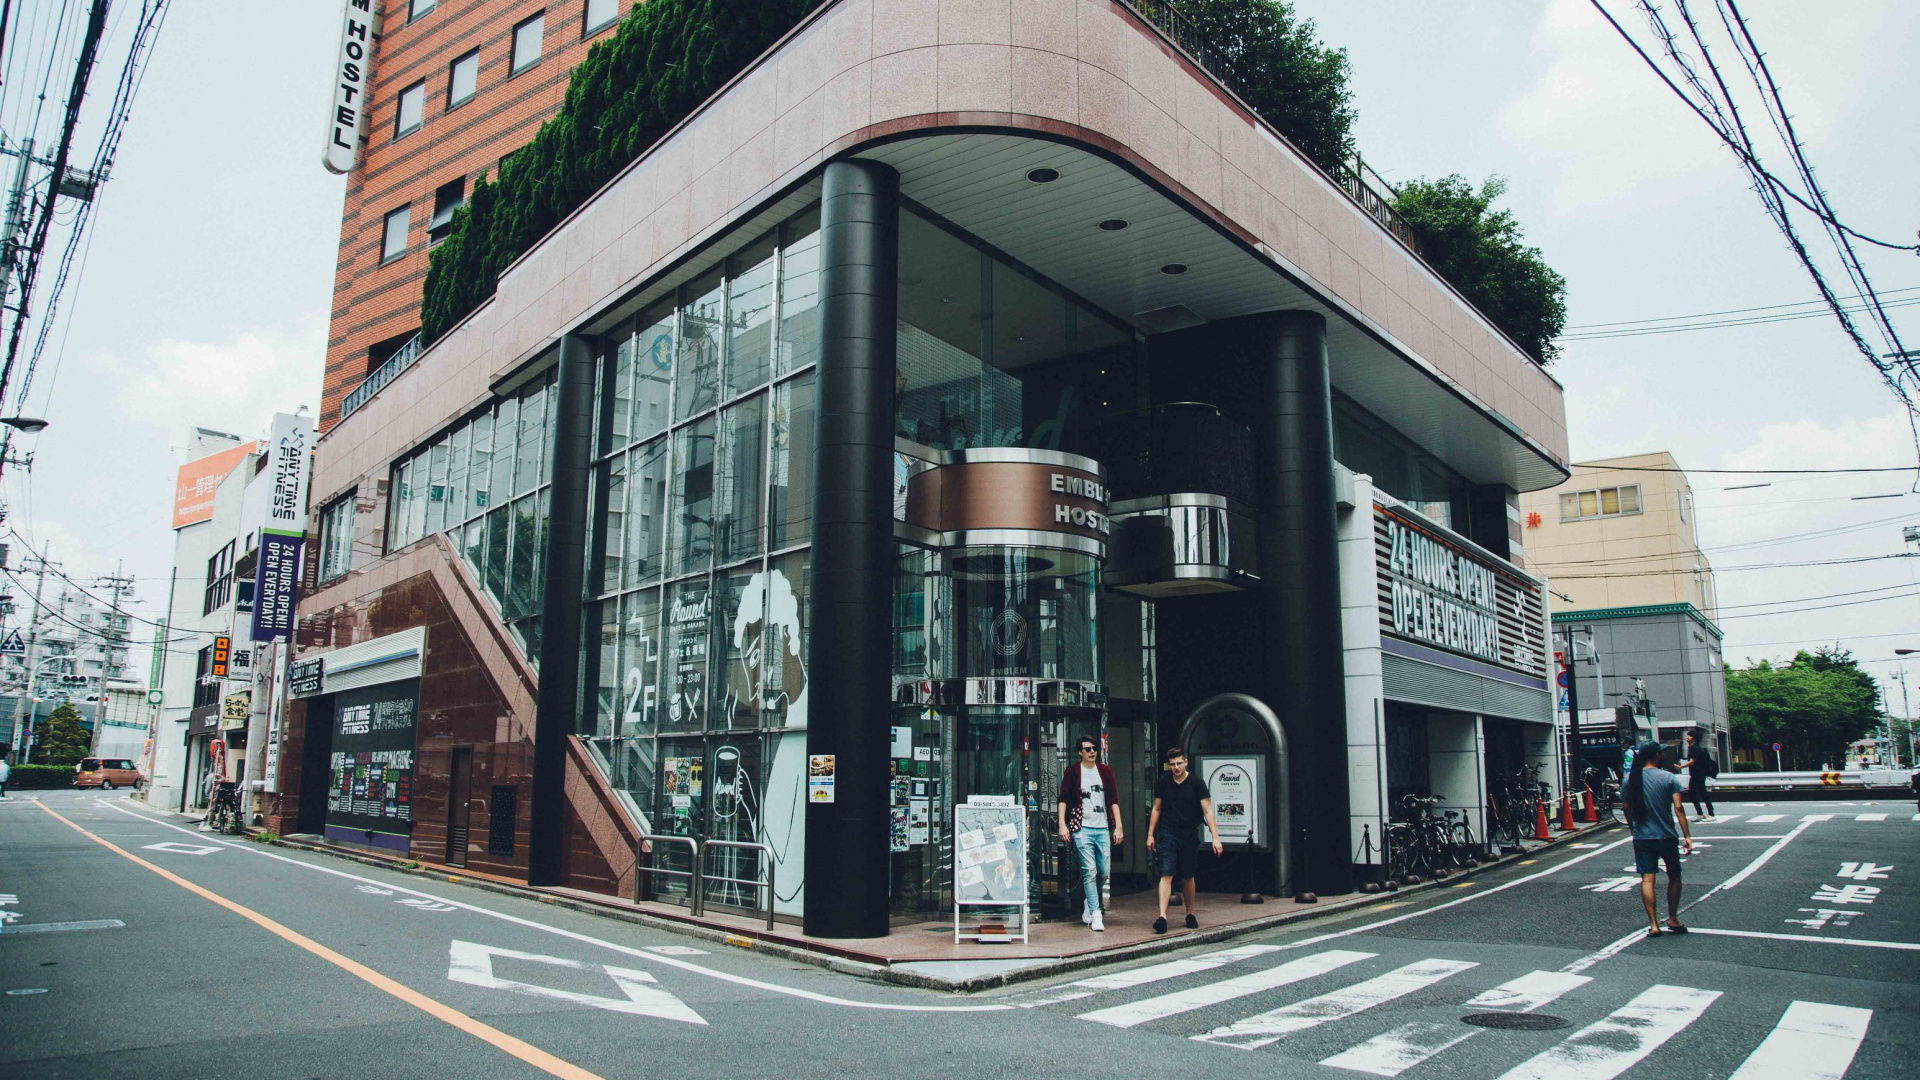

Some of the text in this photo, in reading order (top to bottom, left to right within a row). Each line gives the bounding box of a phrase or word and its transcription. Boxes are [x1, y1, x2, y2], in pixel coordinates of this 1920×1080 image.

[333, 18, 367, 150] HOSTEL
[272, 446, 290, 519] FITNESS
[283, 446, 302, 520] ANYTIME
[1388, 520, 1498, 612] 24 HOURS OPEN!!
[260, 542, 281, 629] OPEN EVERYDAY!!
[275, 544, 295, 629] 24 HOURS OPEN!!
[684, 592, 695, 600] THE
[669, 593, 708, 623] Round
[1391, 580, 1501, 662] OPEN EVERYDAY!!
[232, 649, 251, 668] 福
[292, 660, 321, 680] ANYTIME
[990, 666, 1028, 676] EMBLEM
[291, 676, 320, 694] FITNESS
[625, 667, 656, 722] 2F
[342, 721, 370, 735] FITNESS
[343, 704, 371, 723] ANYTIME
[715, 776, 737, 796] Round
